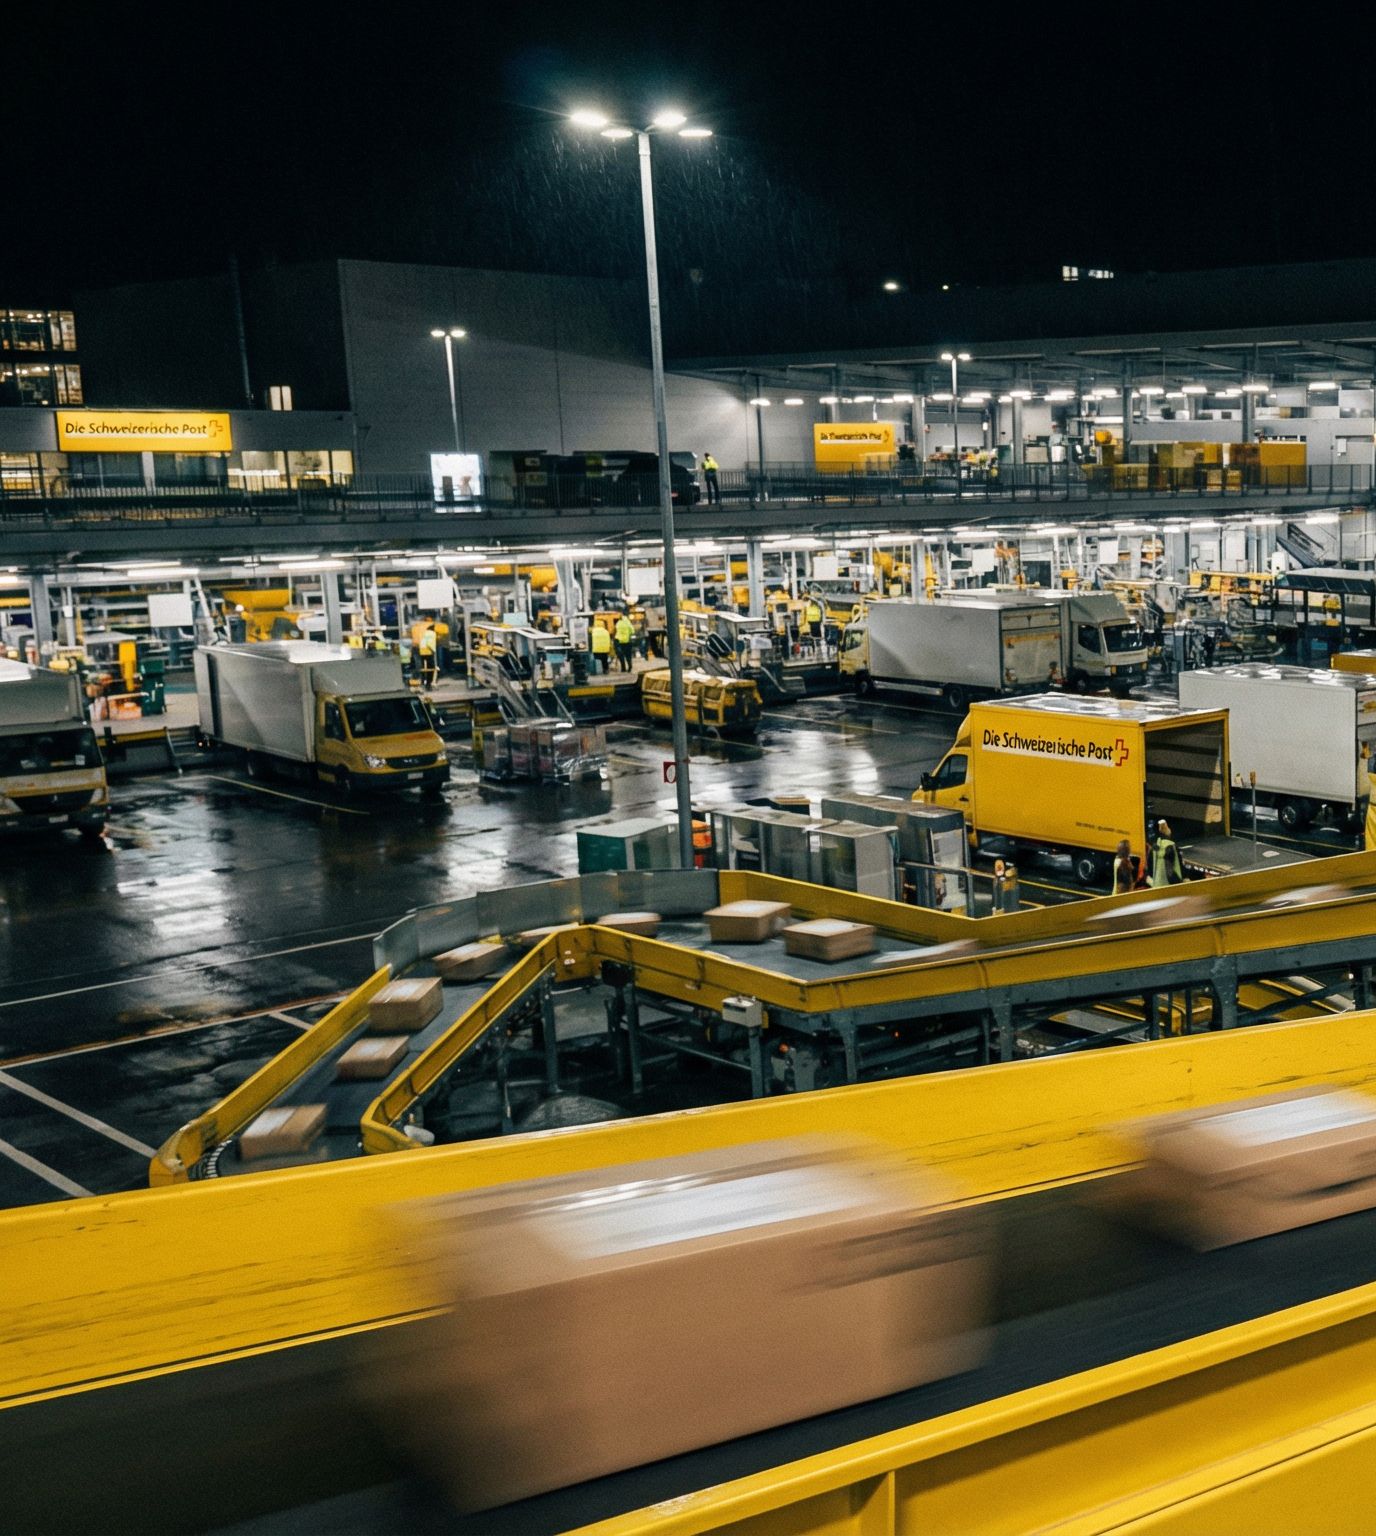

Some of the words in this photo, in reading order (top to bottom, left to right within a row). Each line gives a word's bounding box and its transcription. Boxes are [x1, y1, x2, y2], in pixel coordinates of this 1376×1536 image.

[65, 422, 86, 434] Die
[983, 729, 1001, 747] Die
[1002, 732, 1085, 757] Schweizerische
[1088, 741, 1114, 761] Post
